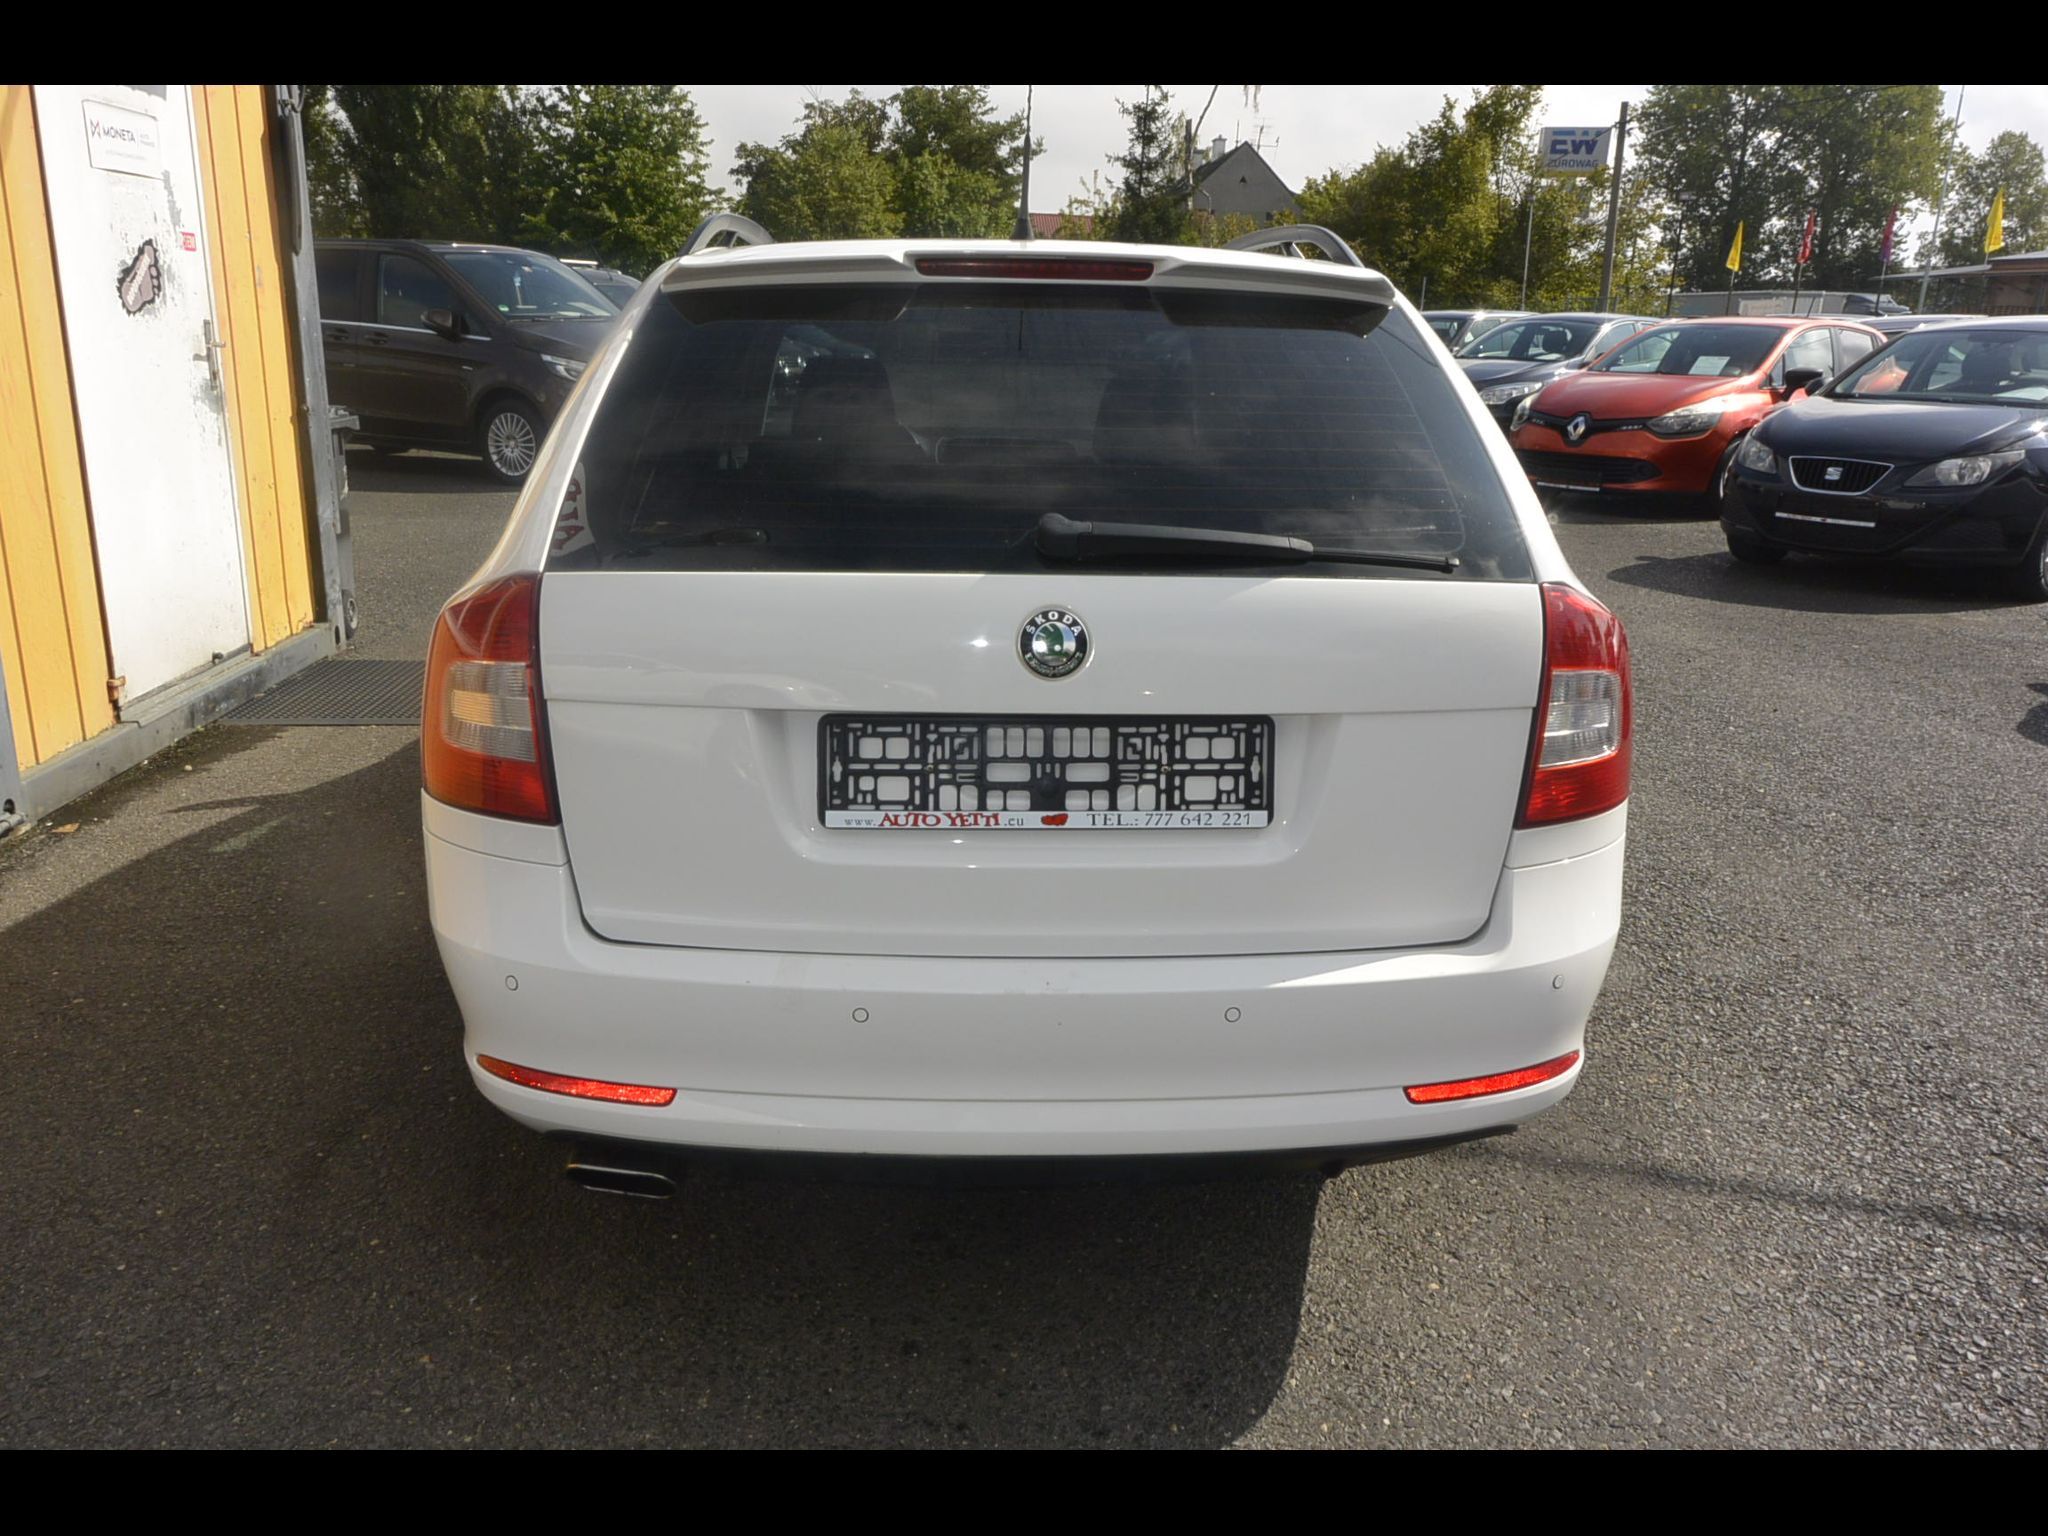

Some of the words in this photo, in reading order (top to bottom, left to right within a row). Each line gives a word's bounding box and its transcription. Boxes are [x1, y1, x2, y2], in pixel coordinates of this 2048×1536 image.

[1144, 812, 1174, 826] 777
[1180, 812, 1213, 826] 642
[1222, 812, 1250, 826] 221
